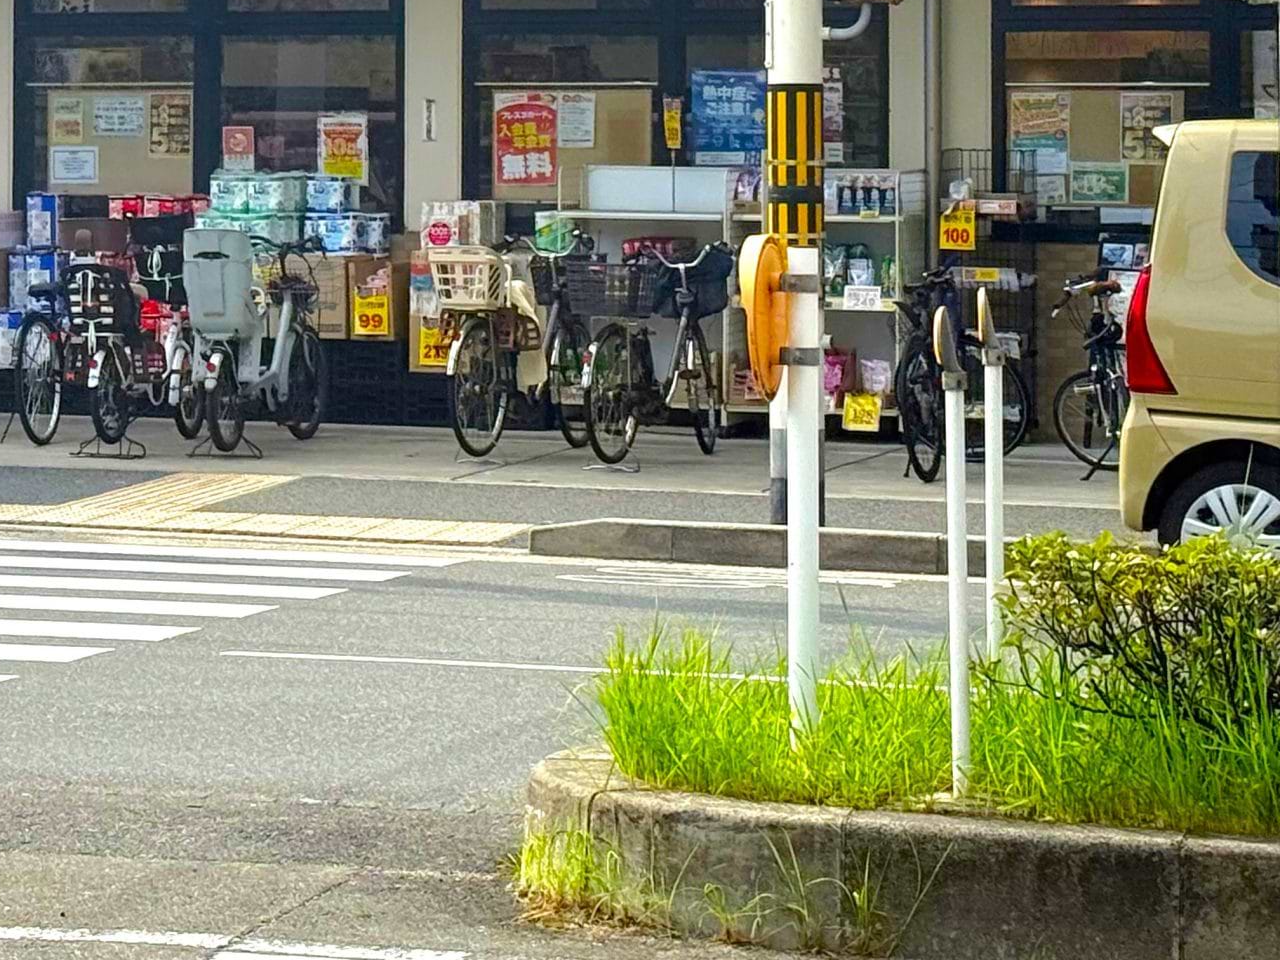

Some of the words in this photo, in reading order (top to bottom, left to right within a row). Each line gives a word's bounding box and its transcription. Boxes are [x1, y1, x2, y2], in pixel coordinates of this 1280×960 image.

[501, 151, 554, 181] 無料
[942, 227, 971, 244] 100
[359, 313, 383, 328] 99
